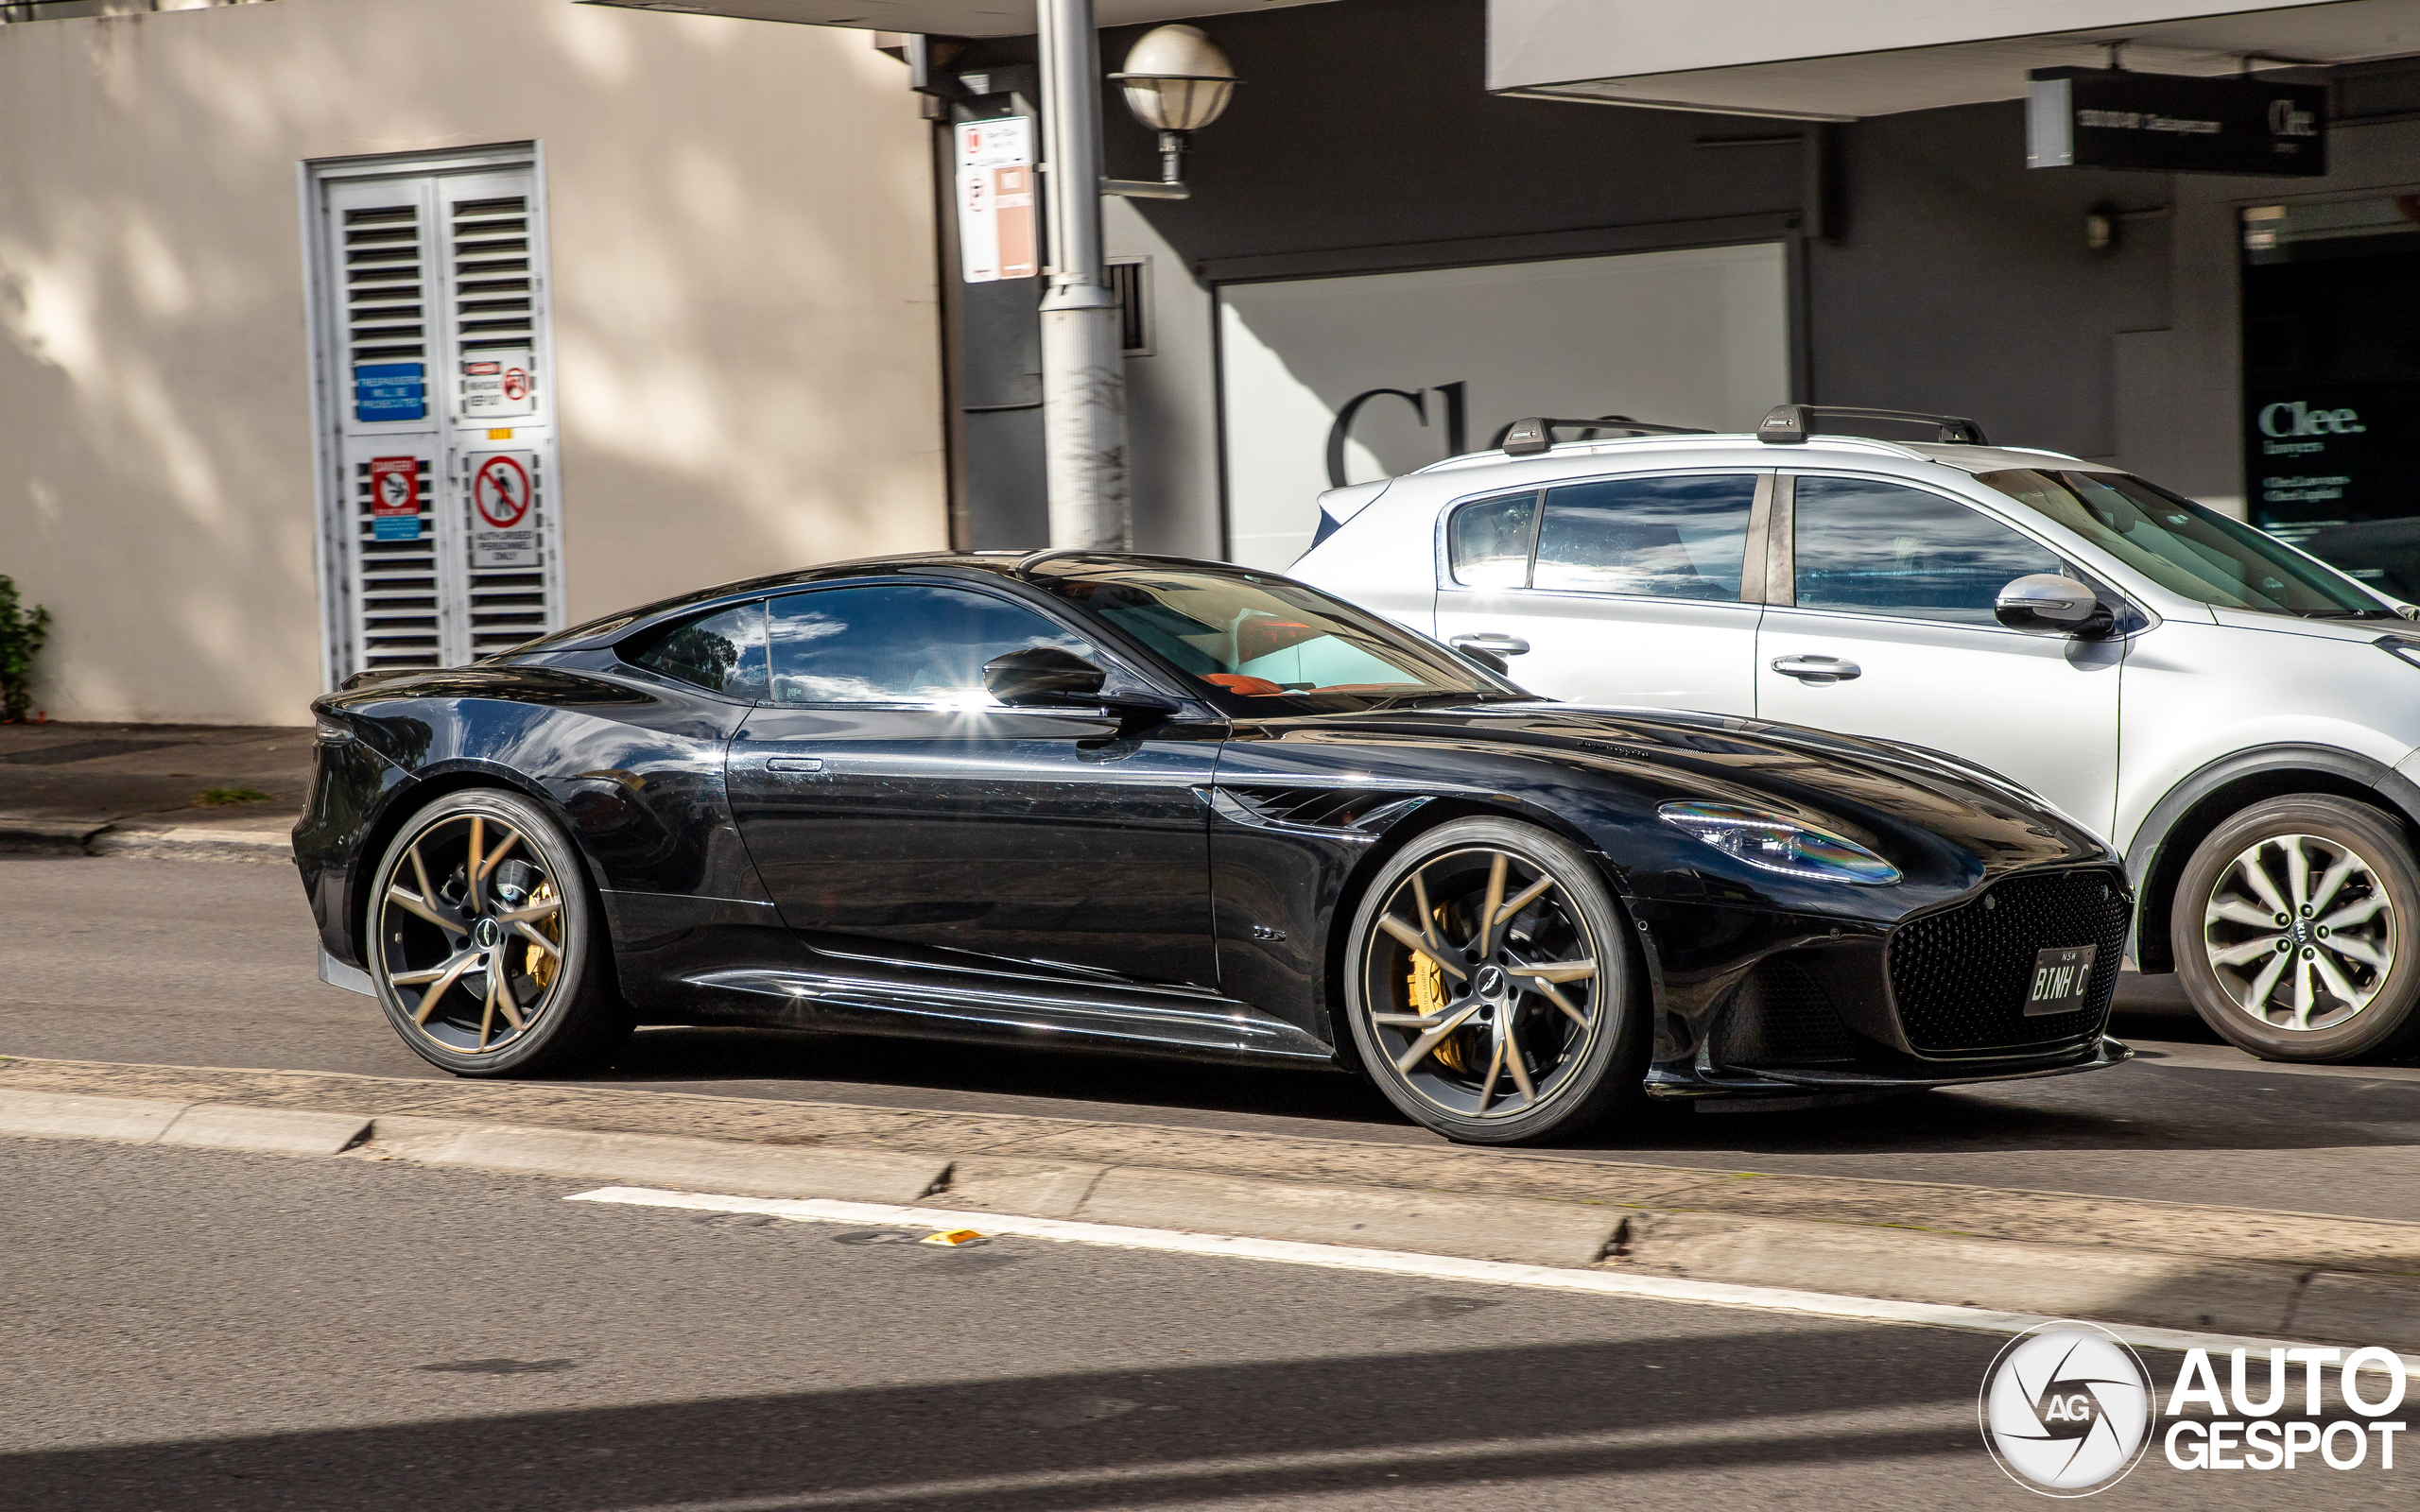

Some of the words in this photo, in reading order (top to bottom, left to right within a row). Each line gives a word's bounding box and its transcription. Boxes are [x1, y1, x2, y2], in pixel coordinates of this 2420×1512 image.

[2295, 921, 2308, 943] KIA
[2061, 952, 2077, 962] NSW
[1420, 966, 1428, 990] MARTIN
[2031, 966, 2075, 1001] BINH
[2075, 964, 2089, 996] C
